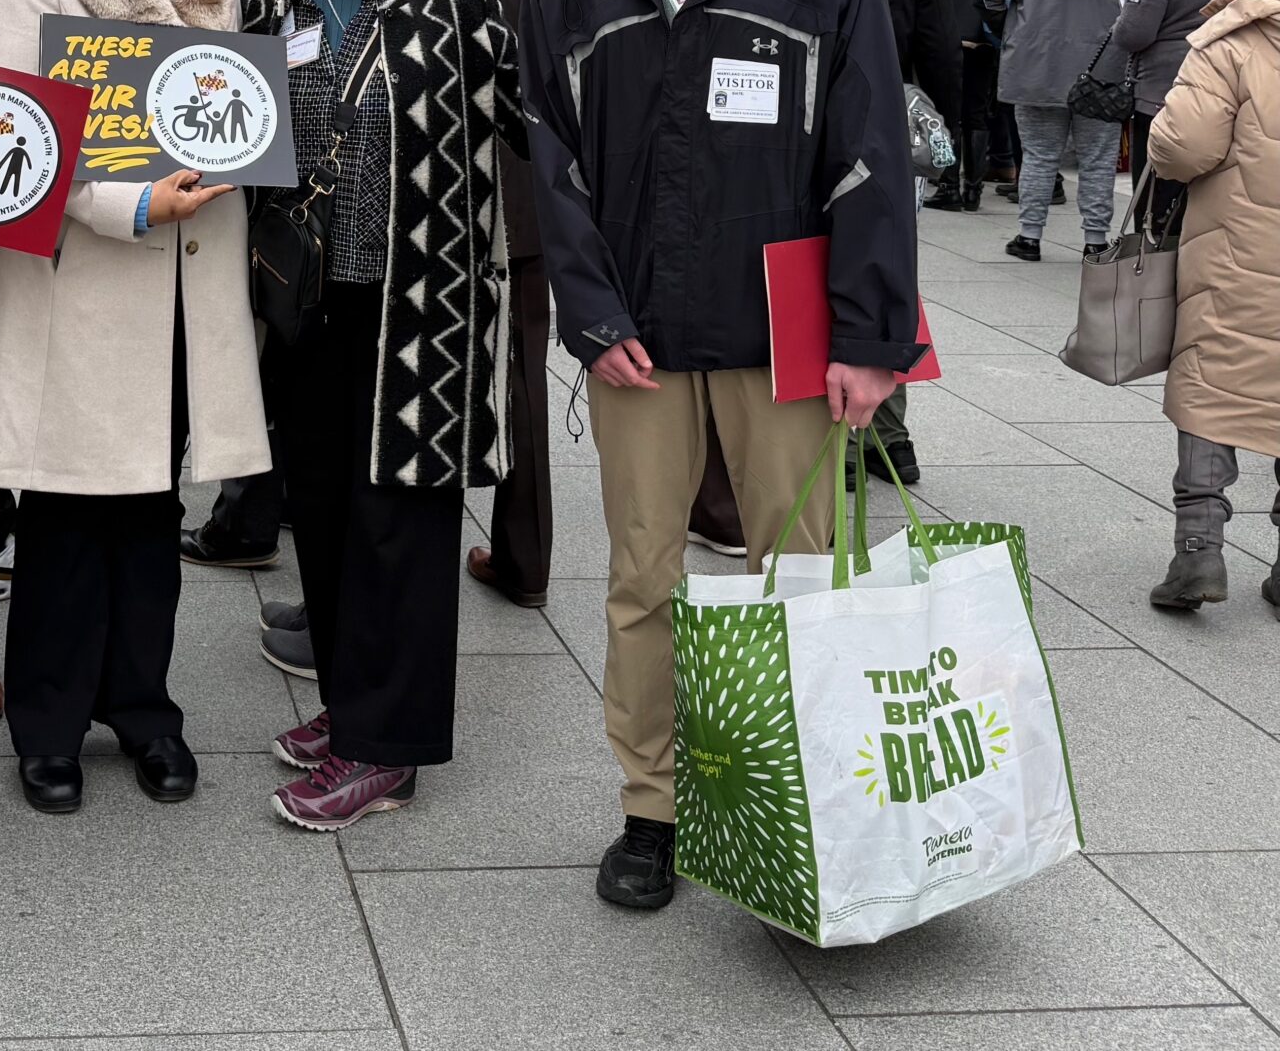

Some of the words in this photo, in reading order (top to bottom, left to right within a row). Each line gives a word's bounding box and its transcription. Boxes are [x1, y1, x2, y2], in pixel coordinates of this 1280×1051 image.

[65, 35, 153, 58] THESE
[48, 58, 110, 81] ARE
[155, 68, 173, 95] PROTECT
[171, 53, 199, 71] SERVICES
[200, 52, 213, 60] FOR
[214, 53, 258, 85] MARYLANDERS
[255, 85, 268, 103] WITH
[716, 77, 775, 89] VISITOR
[89, 83, 137, 111] UR
[7, 94, 49, 136] MARYLANDERS
[43, 136, 53, 156] WITH
[83, 113, 155, 140] VES!
[154, 106, 181, 152] INTELLECTUAL
[180, 149, 195, 161] AND
[196, 148, 254, 166] DEVELOPMENTAL
[253, 113, 270, 149] DISABILITIES
[19, 168, 50, 207] DISABILITIES
[863, 667, 929, 694] TIM
[928, 646, 958, 677] TO
[882, 678, 961, 725] BRAK
[922, 823, 973, 857] Panera
[927, 843, 973, 867] CATERING
